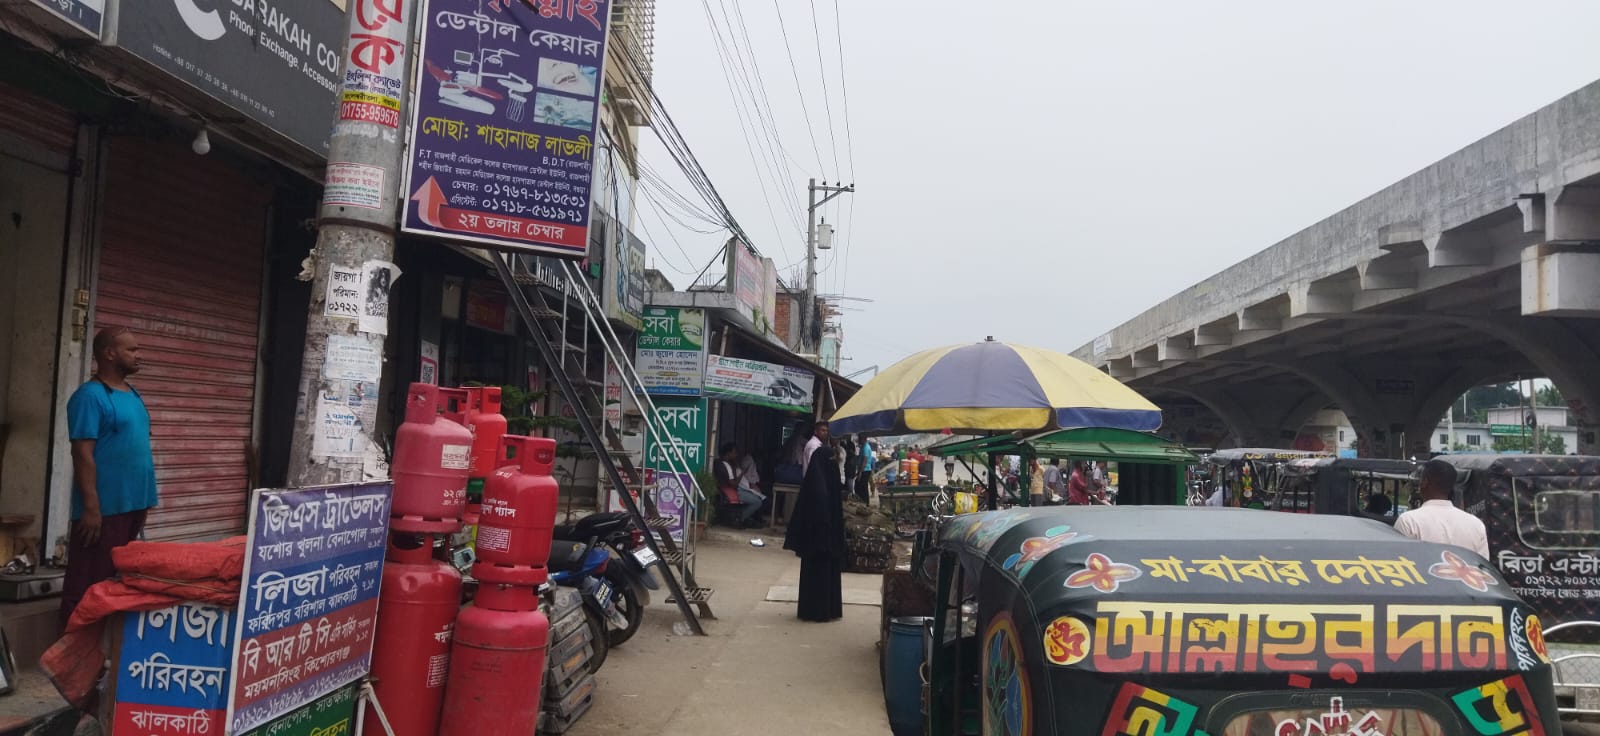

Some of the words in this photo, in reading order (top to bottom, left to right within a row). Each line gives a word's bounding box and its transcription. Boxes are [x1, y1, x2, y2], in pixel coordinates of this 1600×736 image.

[260, 31, 300, 70] Exchange,
[436, 10, 520, 43] ডেন্টাল
[529, 29, 601, 58] কেয়ার
[476, 123, 541, 153] শাহানাজ
[545, 134, 593, 160] লাভলী
[482, 198, 583, 223] ০১৭১৮-৫৬১৯৭১
[484, 182, 587, 208] ০১৭৬৭-৮১৩৫৩১
[458, 212, 480, 228] ২য়
[484, 216, 523, 235] তলায়
[526, 223, 566, 240] চেম্বার
[653, 404, 701, 430] সেবা
[262, 495, 320, 538] জিএস
[258, 541, 293, 562] যশোর
[296, 534, 324, 559] খুলনা
[327, 526, 368, 549] বেনাপোল
[1140, 555, 1311, 586] মা-বাবার
[1311, 555, 1428, 587] দোয়া
[1497, 550, 1544, 574] রিতা
[1550, 552, 1600, 575] এন্টা
[251, 565, 329, 613] লিজা
[328, 563, 362, 589] পরিবহন
[294, 597, 326, 623] বরিশাল
[242, 638, 262, 679] বি
[265, 634, 296, 668] আর
[298, 621, 313, 656] টি
[314, 617, 332, 649] সি
[1386, 604, 1508, 672] দান
[128, 652, 227, 699] পরিবহন
[130, 708, 212, 735] ঝালকাঠি
